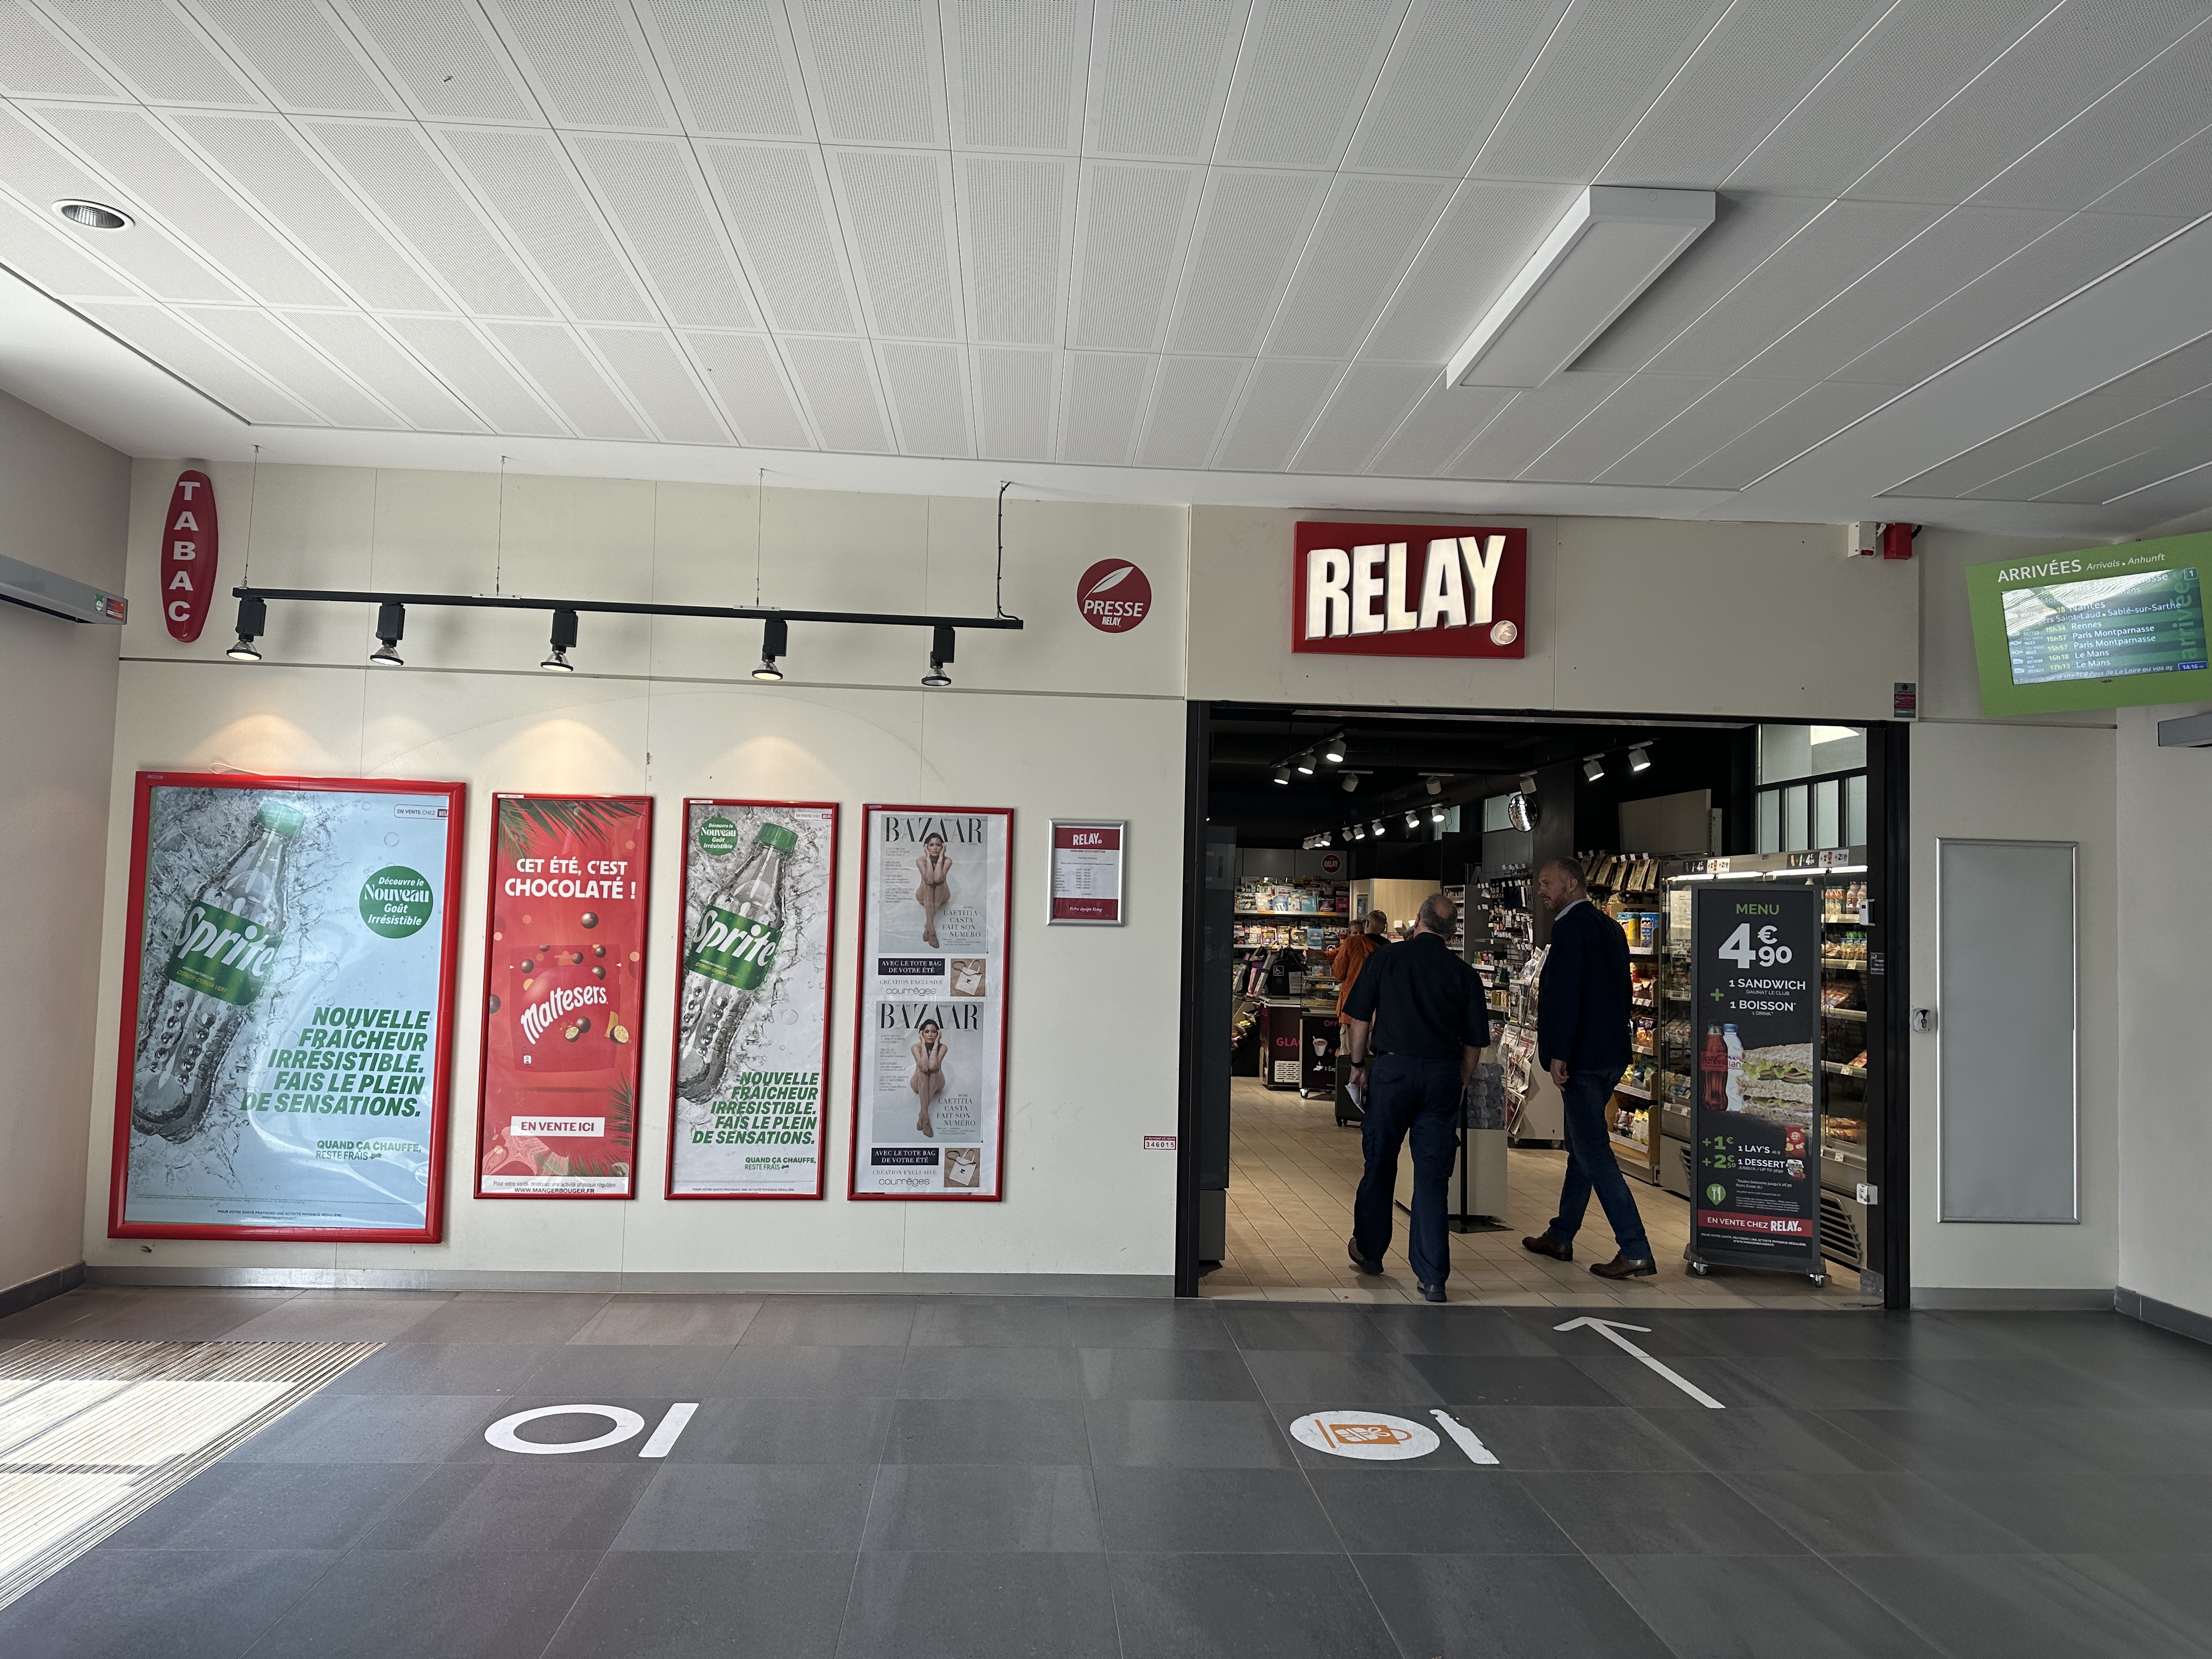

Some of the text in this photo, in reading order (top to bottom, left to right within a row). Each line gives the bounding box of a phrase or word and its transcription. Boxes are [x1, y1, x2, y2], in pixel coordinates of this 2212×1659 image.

[168, 481, 200, 622] TABAC
[1998, 559, 2082, 583] ARRIVÉES
[2086, 560, 2120, 571] Arrivals
[1305, 535, 1506, 641] RELAY
[1084, 600, 1144, 617] PRESSE
[2056, 601, 2181, 622] Saint-Laud Sablé-sur-Sarthe
[2070, 602, 2106, 612] Nantes
[1102, 616, 1121, 626] RELAY
[2071, 622, 2102, 630] Rennes
[2094, 625, 2155, 637] Montparnasse
[2096, 635, 2156, 647] Montparnasse
[701, 827, 736, 837] Nouveau
[885, 817, 984, 843] BAZAAR
[1073, 833, 1099, 845] RELAY
[517, 856, 627, 876] CET ÉTÉ, C'EST
[379, 877, 415, 886] Découvre
[505, 877, 623, 899] CHOCOLATÉ
[364, 884, 429, 902] Nouveau
[384, 904, 408, 913] Goût
[1736, 904, 1780, 915] MENU
[368, 914, 422, 926] Irrésistible
[175, 906, 275, 977] Sprite
[693, 910, 776, 967] Sprite
[1738, 978, 1805, 990] SANDWICH
[886, 988, 936, 996] courrèges
[312, 1007, 431, 1029] NOUVELLE
[521, 985, 607, 1045] Maltesers
[878, 1003, 980, 1030] BAZAAR
[298, 1026, 427, 1051] FRAÎCHEUR
[1276, 1037, 1300, 1047] GLA
[268, 1043, 424, 1073] IRRÉSISTIBLE.
[273, 1071, 426, 1094] FAIS LE PLEIN
[740, 1072, 820, 1085] NOUVELLE
[731, 1084, 819, 1100] FRAÎCHEUR
[240, 1092, 421, 1117] DE SENSATIONS.
[710, 1098, 816, 1114] IRRÉSISTIBLE.
[521, 1121, 594, 1131] EN VENTE ICI
[715, 1116, 817, 1130] FAIS LE PLEIN
[692, 1131, 815, 1144] DE SENSATIONS.
[317, 1140, 421, 1153] QUAND ÇA CHAUFFE,
[1745, 1145, 1770, 1153] LAY'S
[315, 1150, 368, 1160] RESTE FRAIS
[1745, 1158, 1785, 1168] DESSERT
[879, 1178, 930, 1187] courrèges
[1719, 1218, 1745, 1227] VENTE
[1747, 1221, 1768, 1229] CHEZ
[1770, 1220, 1798, 1232] RELAY
